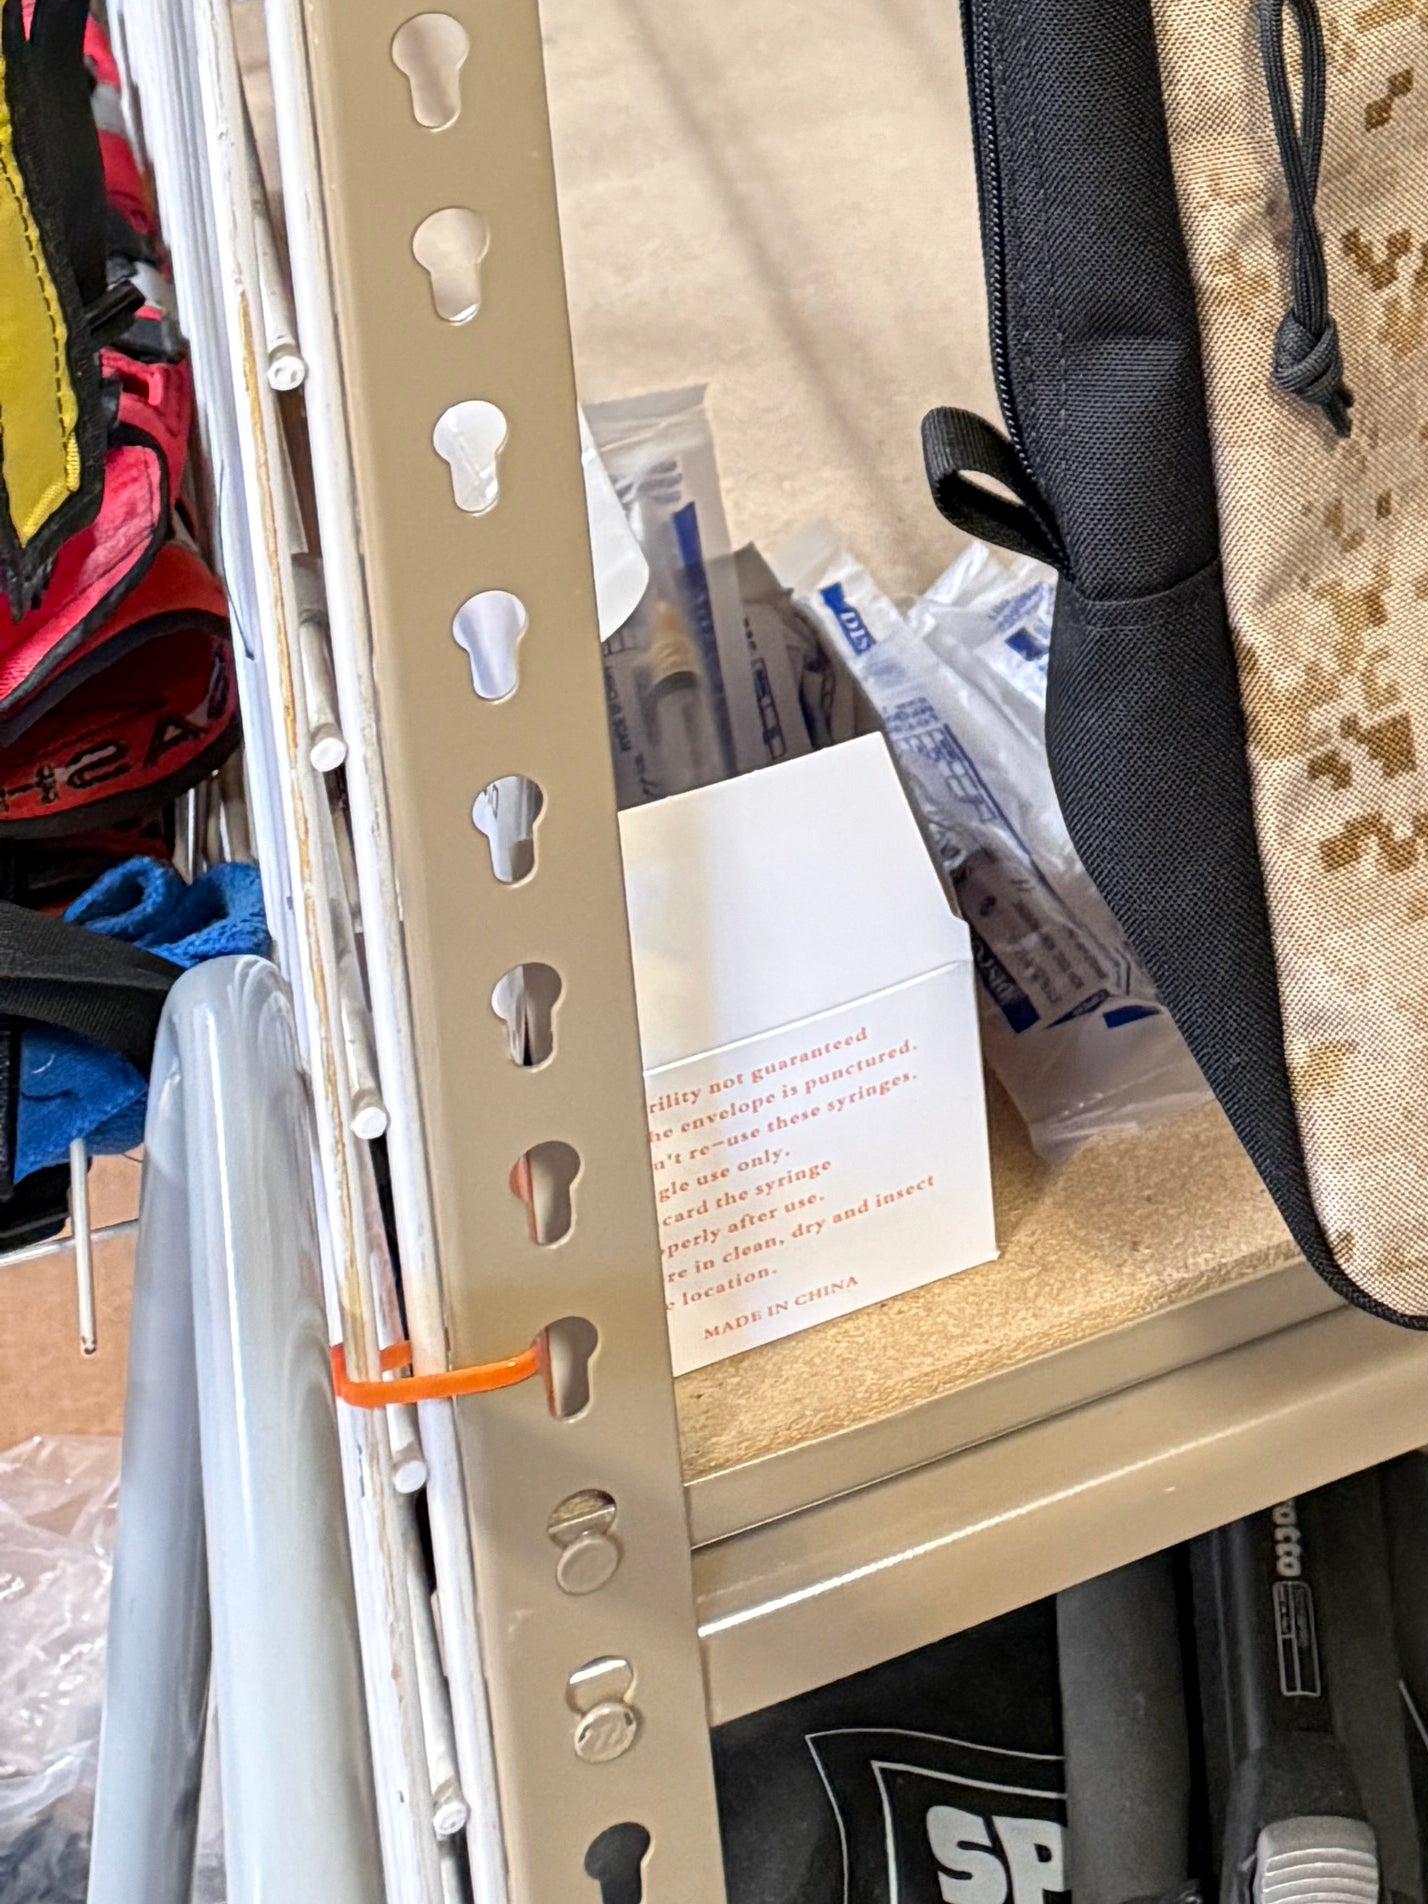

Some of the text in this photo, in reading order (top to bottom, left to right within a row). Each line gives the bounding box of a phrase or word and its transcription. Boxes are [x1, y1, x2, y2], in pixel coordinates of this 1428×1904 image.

[680, 1094, 776, 1133] envelope
[781, 1083, 798, 1100] is
[804, 1040, 918, 1096] punctured.
[708, 1074, 744, 1095] not
[751, 1027, 868, 1084] guaranteed
[767, 1105, 820, 1133] these
[826, 1073, 917, 1113] syringes.
[662, 1159, 832, 1227] card the syringe
[697, 1166, 730, 1188] use
[737, 1147, 791, 1172] only.
[695, 1258, 715, 1274] in
[722, 1236, 785, 1264] clean,
[791, 1216, 826, 1240] dry
[832, 1198, 870, 1225] and
[875, 1174, 935, 1208] insect
[727, 1205, 778, 1234] after
[784, 1193, 825, 1214] use.
[682, 1269, 778, 1306] location.
[702, 1275, 859, 1340] MADE IN CHINA
